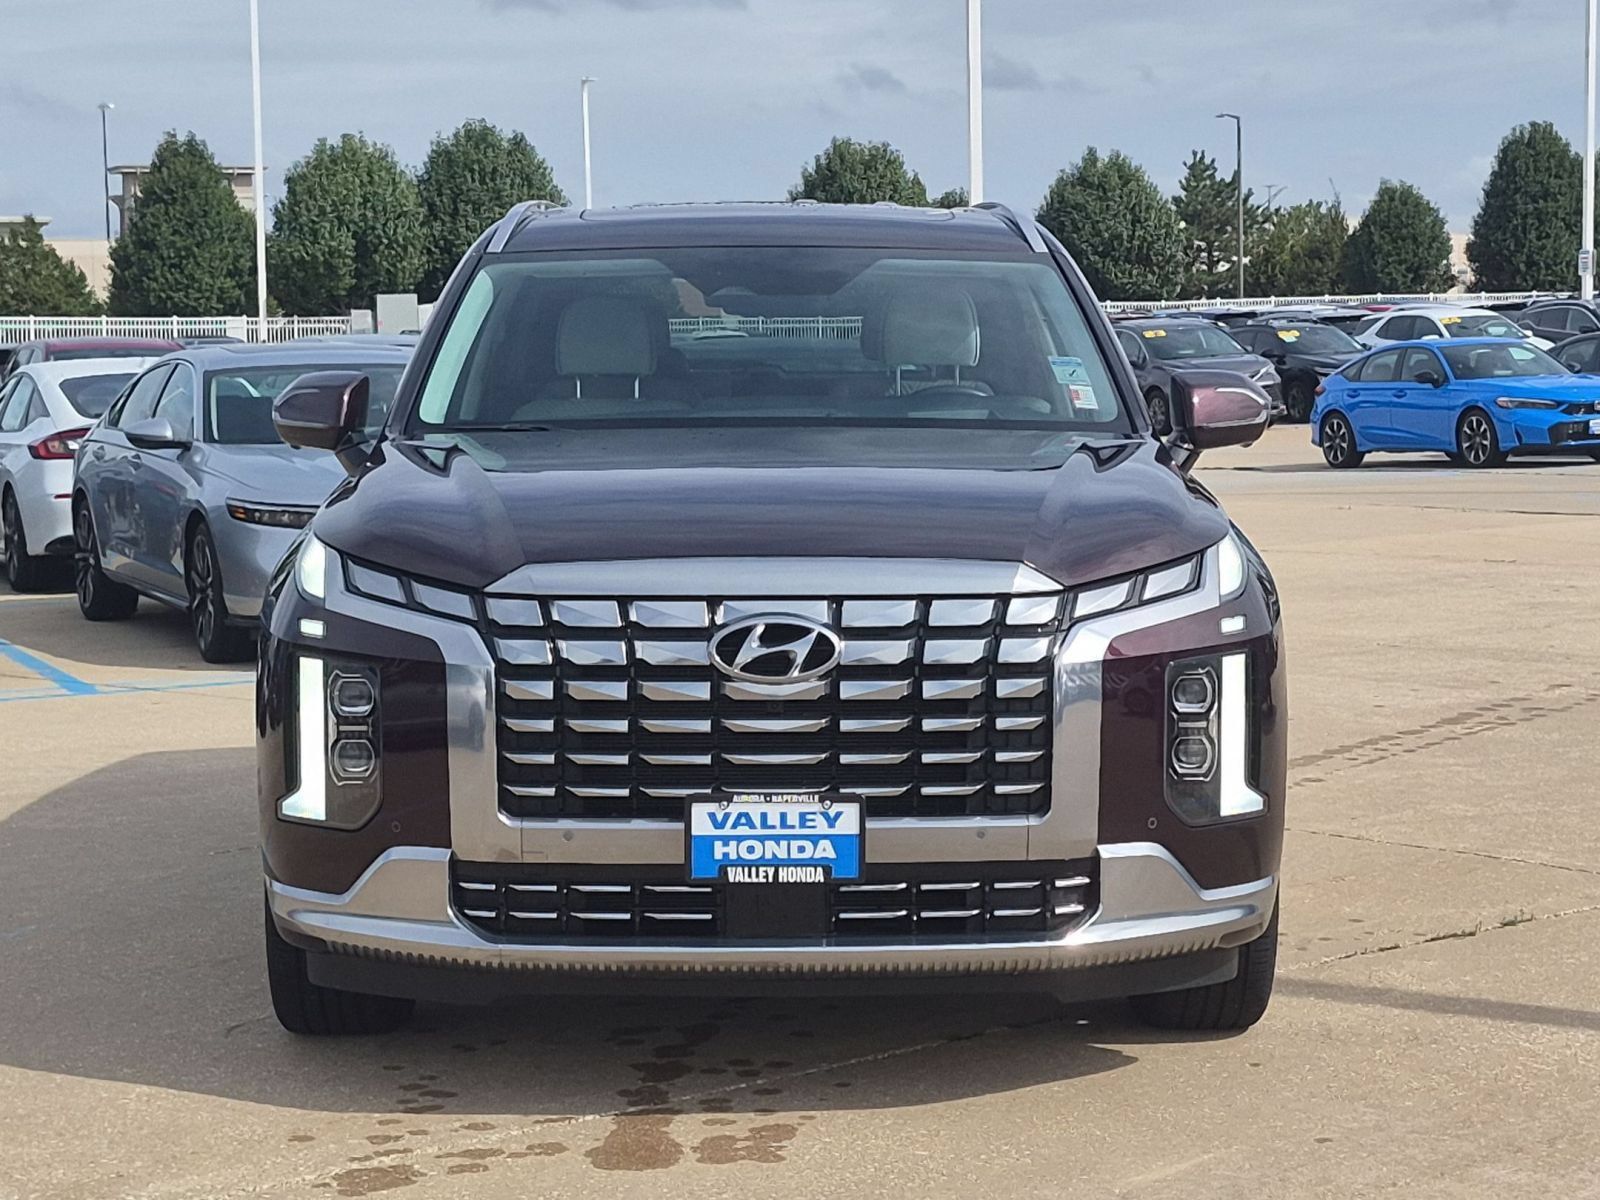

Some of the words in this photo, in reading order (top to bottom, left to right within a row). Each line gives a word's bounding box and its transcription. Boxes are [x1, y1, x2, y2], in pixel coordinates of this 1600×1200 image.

[707, 811, 844, 830] VALLEY
[714, 839, 837, 860] HONDA
[727, 866, 775, 883] VALLEY
[778, 866, 824, 883] HONDA
